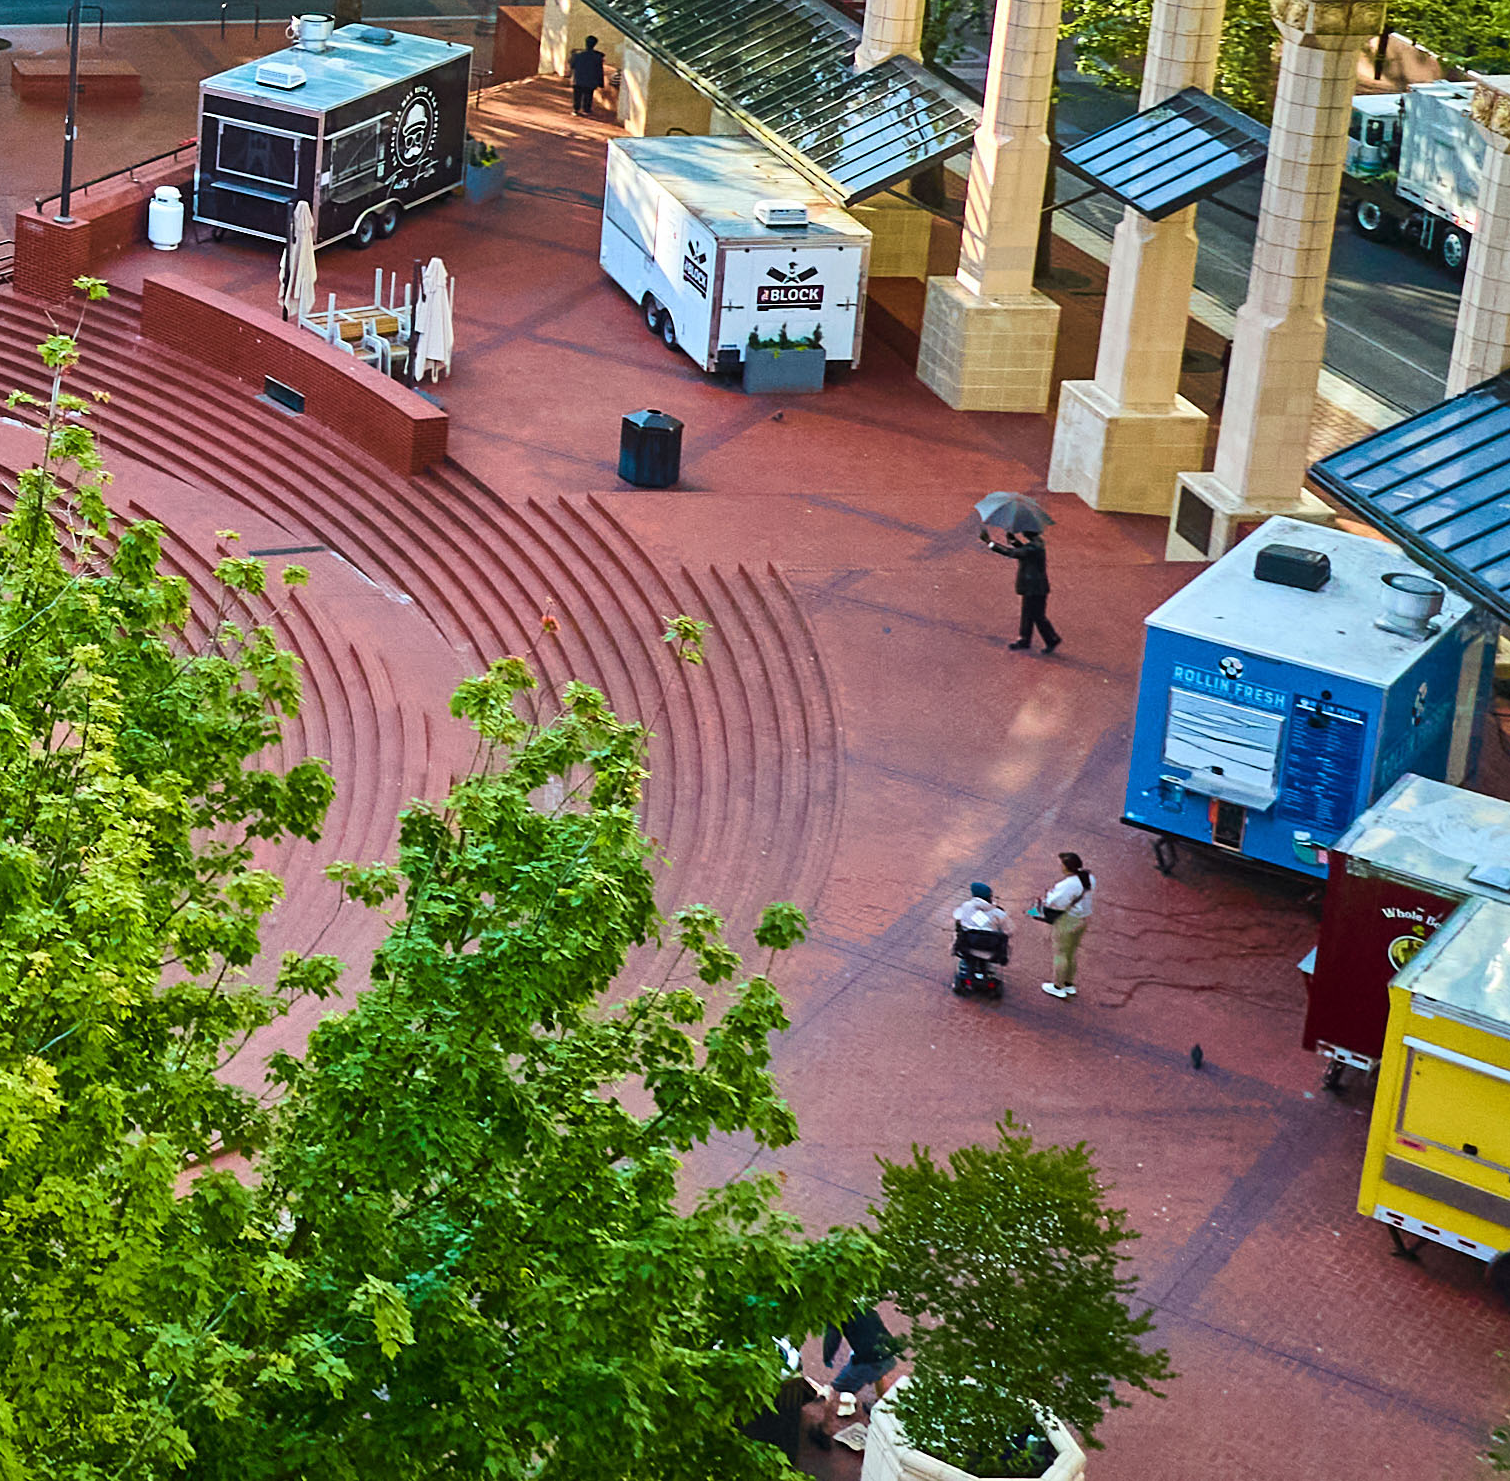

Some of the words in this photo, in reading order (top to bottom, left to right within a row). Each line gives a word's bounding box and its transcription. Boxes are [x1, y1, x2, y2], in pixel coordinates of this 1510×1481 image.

[770, 288, 819, 301] BLOCK
[1174, 666, 1230, 692] ROLLIN
[1234, 682, 1286, 708] FRESH
[1381, 907, 1423, 922] Whole
